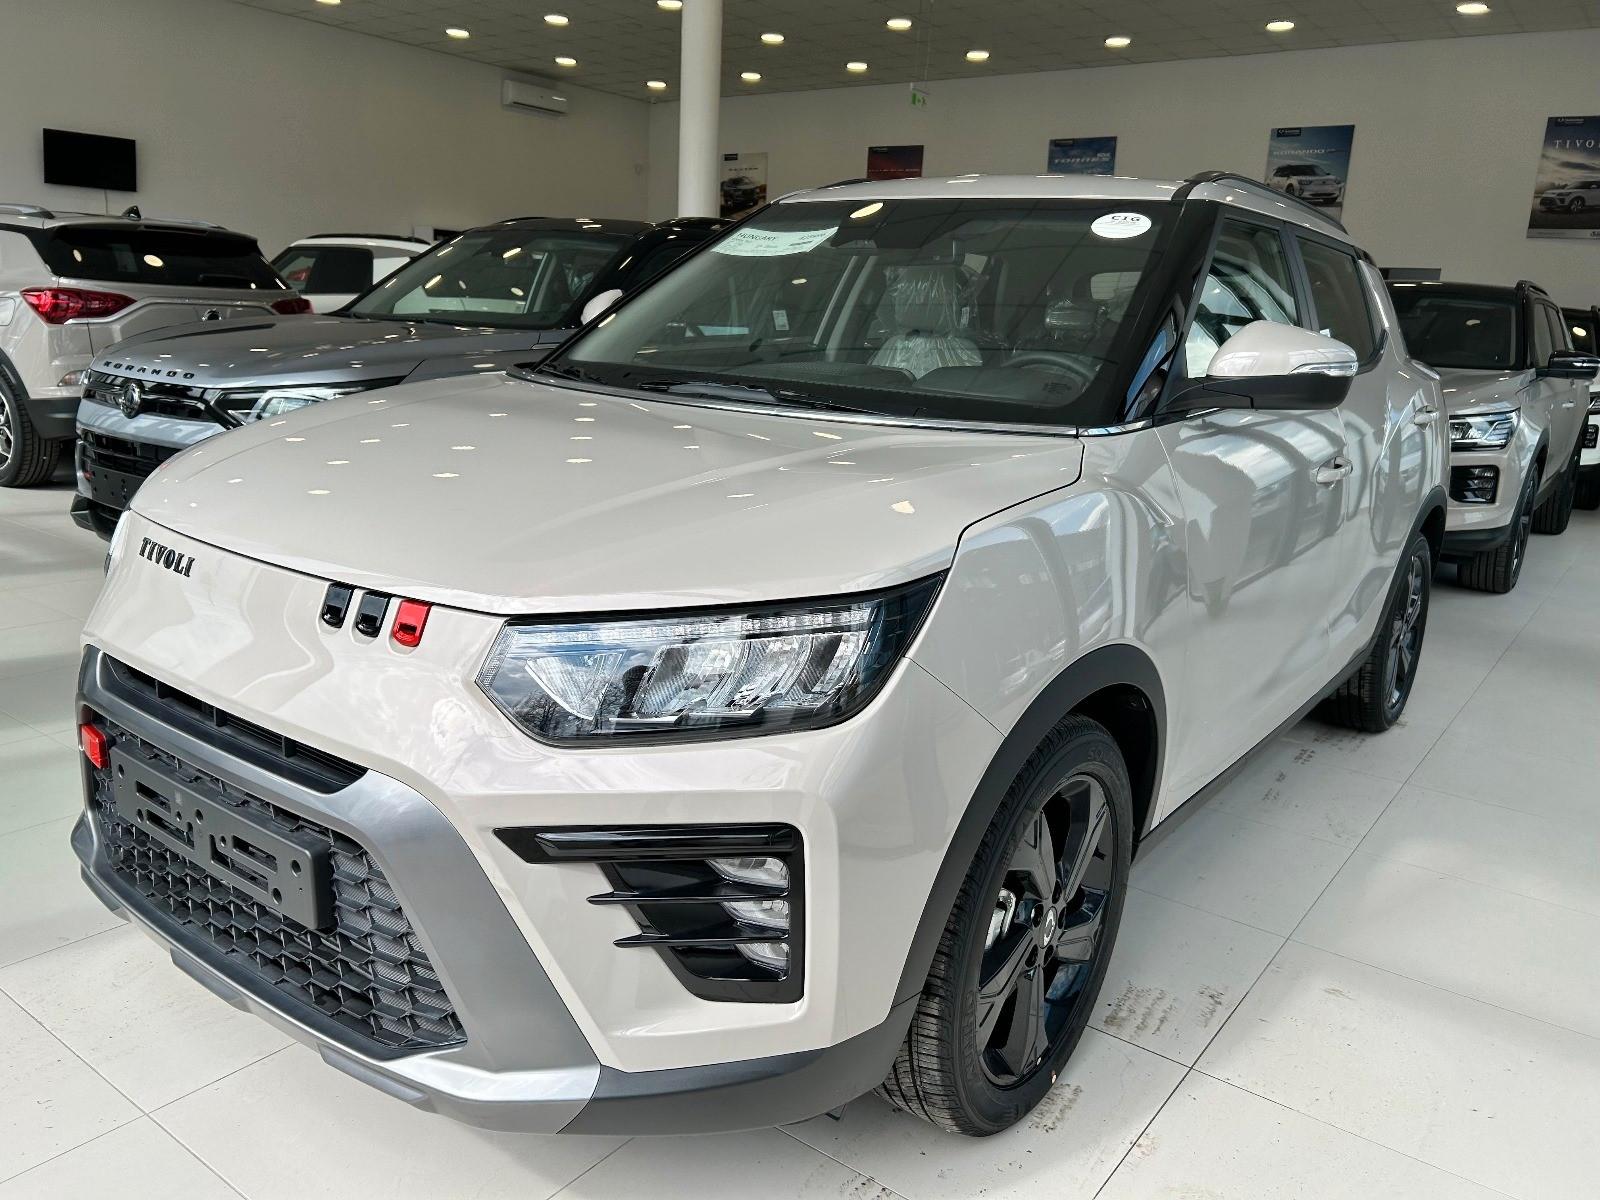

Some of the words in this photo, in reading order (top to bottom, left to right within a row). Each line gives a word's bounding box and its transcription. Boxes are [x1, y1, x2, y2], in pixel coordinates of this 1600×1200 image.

[1554, 139, 1600, 149] TIVO
[738, 232, 778, 241] HUNGARY
[103, 360, 195, 379] KORANDO
[139, 536, 195, 577] TIVOLI
